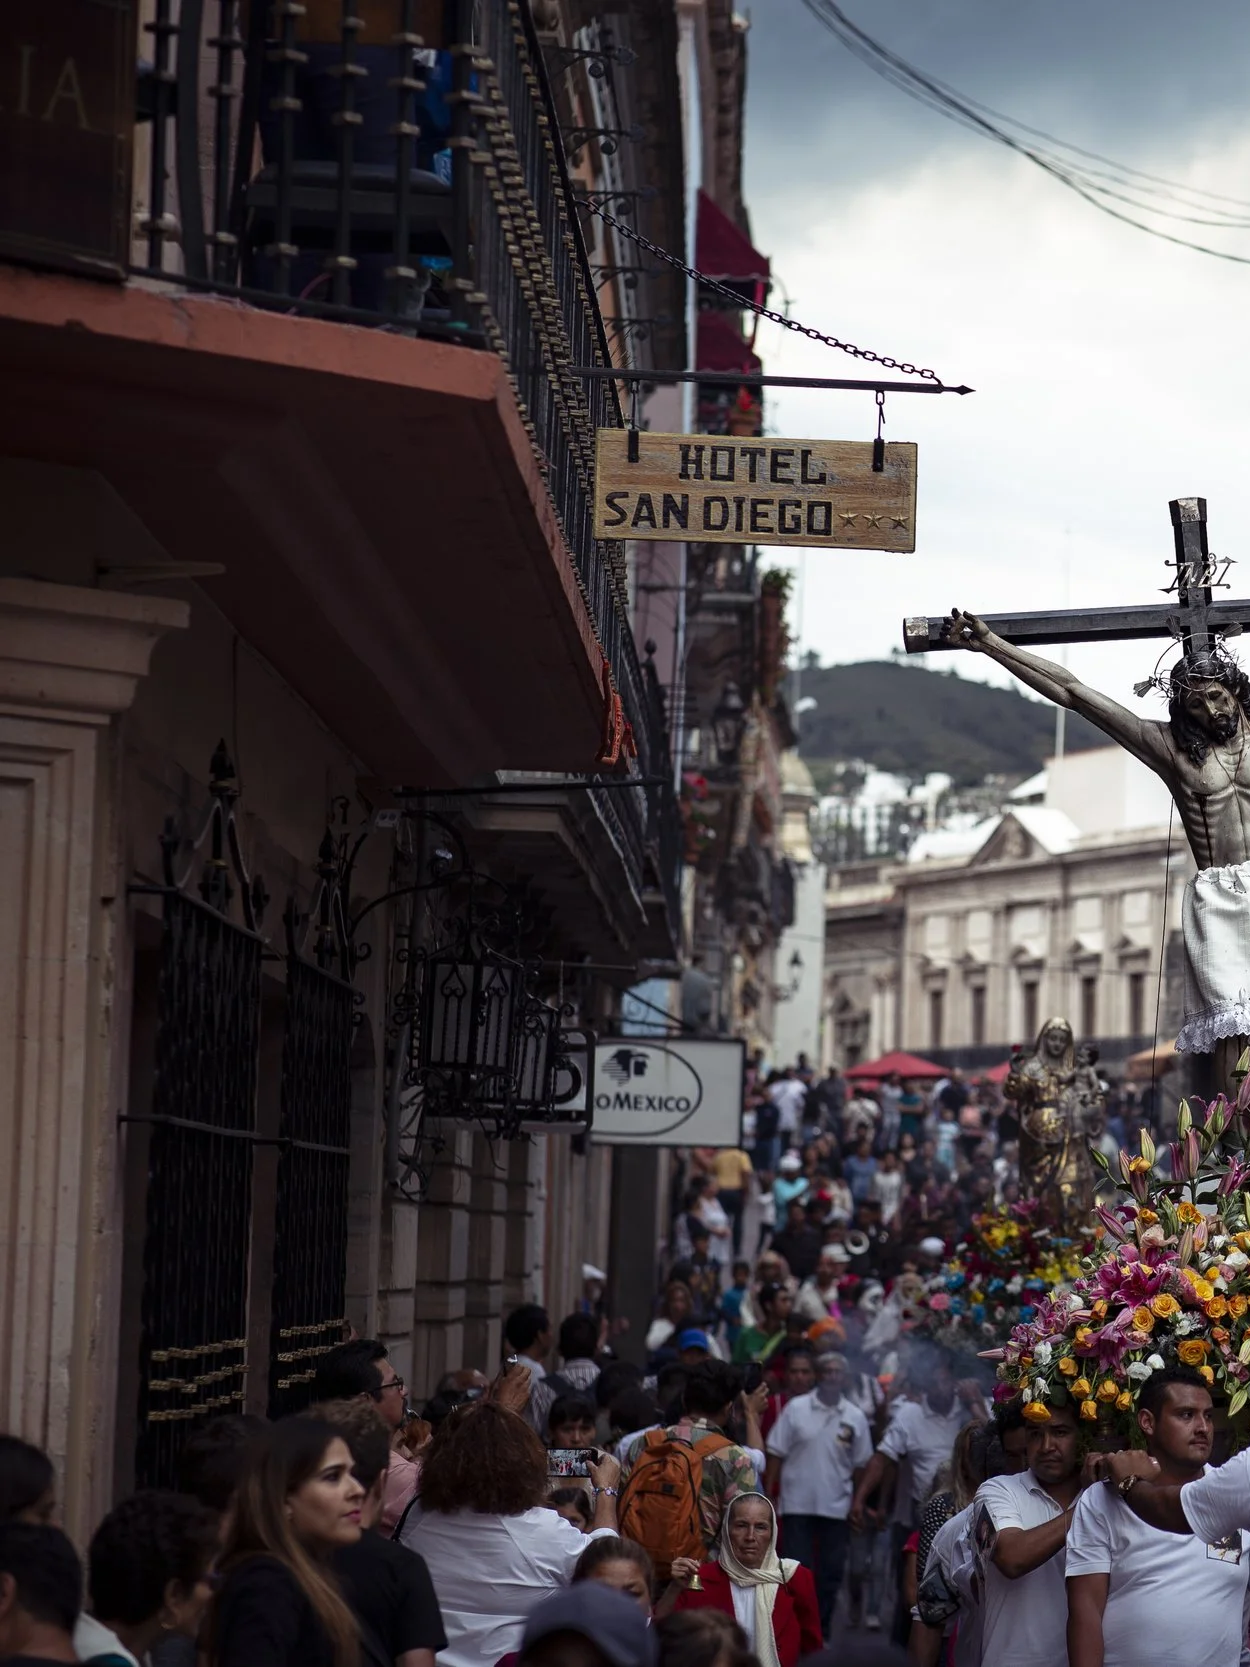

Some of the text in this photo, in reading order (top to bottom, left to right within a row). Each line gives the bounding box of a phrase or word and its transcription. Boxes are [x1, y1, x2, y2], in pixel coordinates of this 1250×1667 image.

[678, 443, 827, 485] HOTEL
[603, 491, 833, 537] SAN DIEGO
